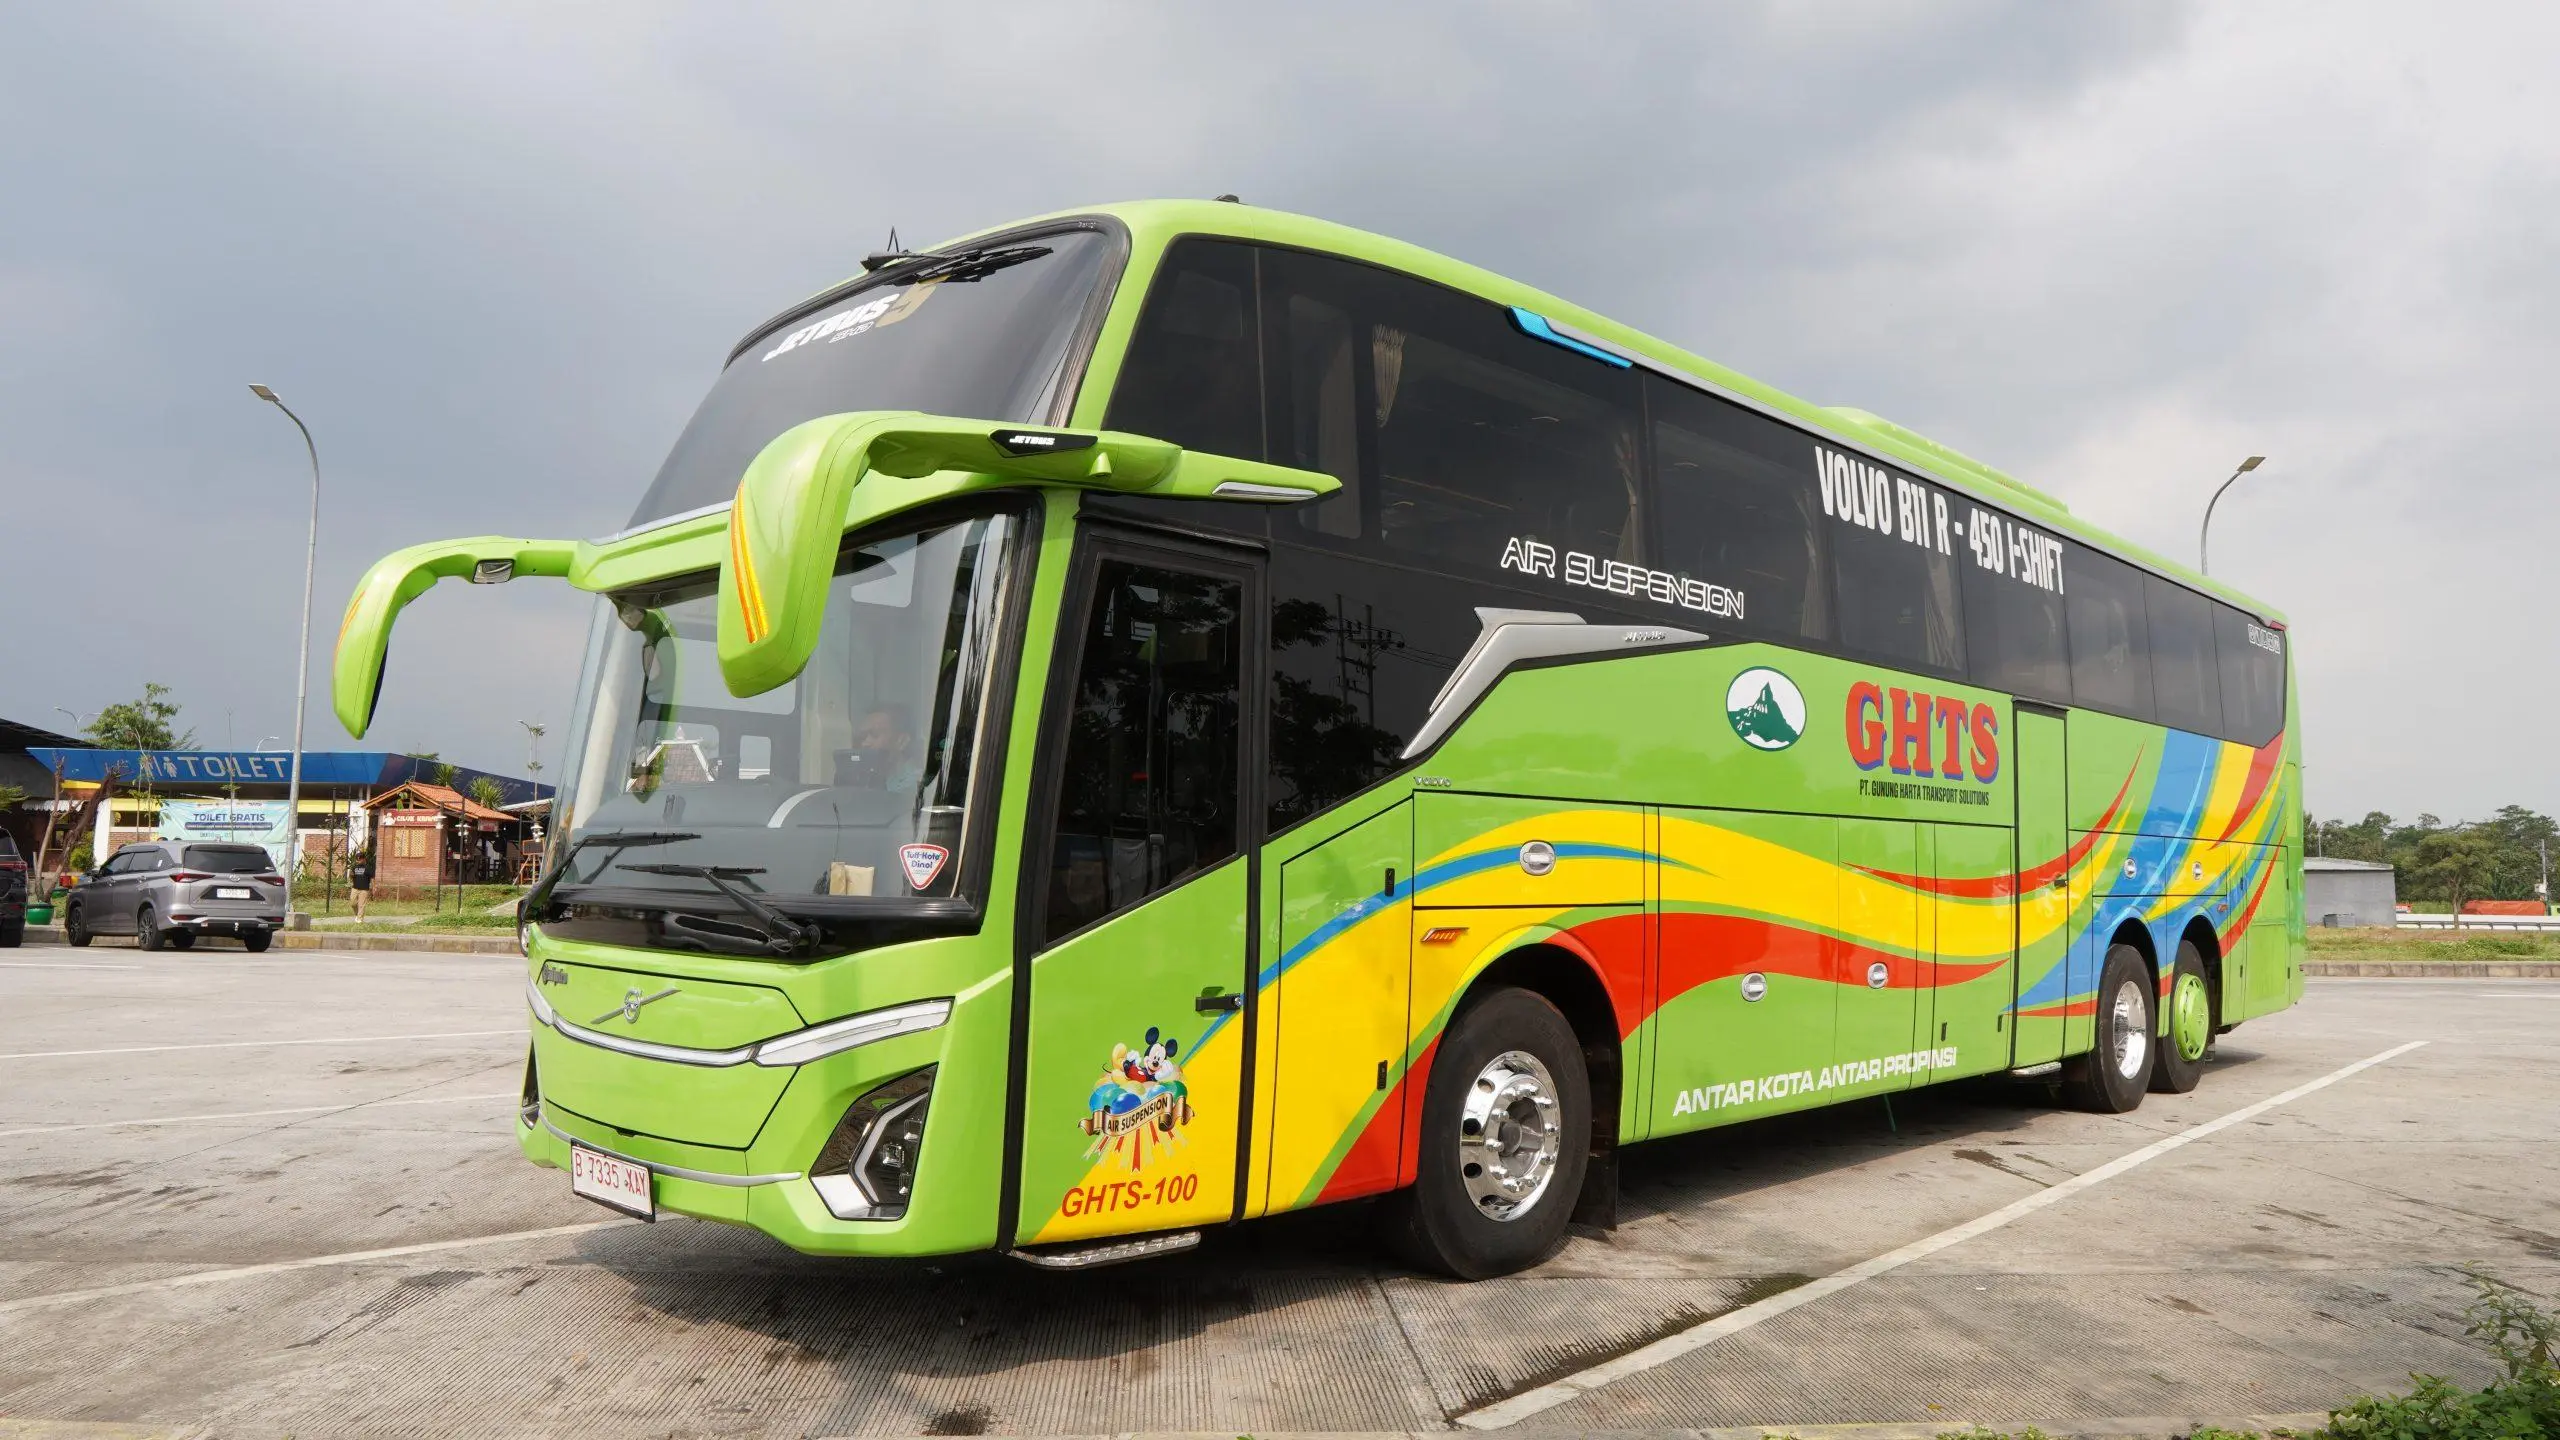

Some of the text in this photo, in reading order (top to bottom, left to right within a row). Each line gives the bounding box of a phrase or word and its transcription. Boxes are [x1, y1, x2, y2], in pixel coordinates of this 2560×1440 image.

[1815, 445, 1892, 536] VOLVO
[1897, 477, 1931, 549] B11
[1933, 492, 1951, 556] R
[1969, 507, 2004, 575] 450
[2006, 521, 2064, 595] I-SHIFT
[1500, 537, 1744, 620] AIR SUSPENSION
[1845, 681, 2000, 784] GHTS
[177, 756, 287, 778] TOILET
[1859, 779, 1990, 806] PT. GUNUNG HARTA TRANSPORT SOLUTIONS
[193, 813, 266, 822] TOILET GRATIS
[911, 861, 933, 869] Dinol
[1672, 1046, 1958, 1117] ANTAR KOTA ANTAR PROPINSI
[1107, 1096, 1169, 1132] AIR SUSPENSION
[575, 1152, 647, 1197] B 7335 XAY
[1061, 1173, 1198, 1218] GHTS-100
